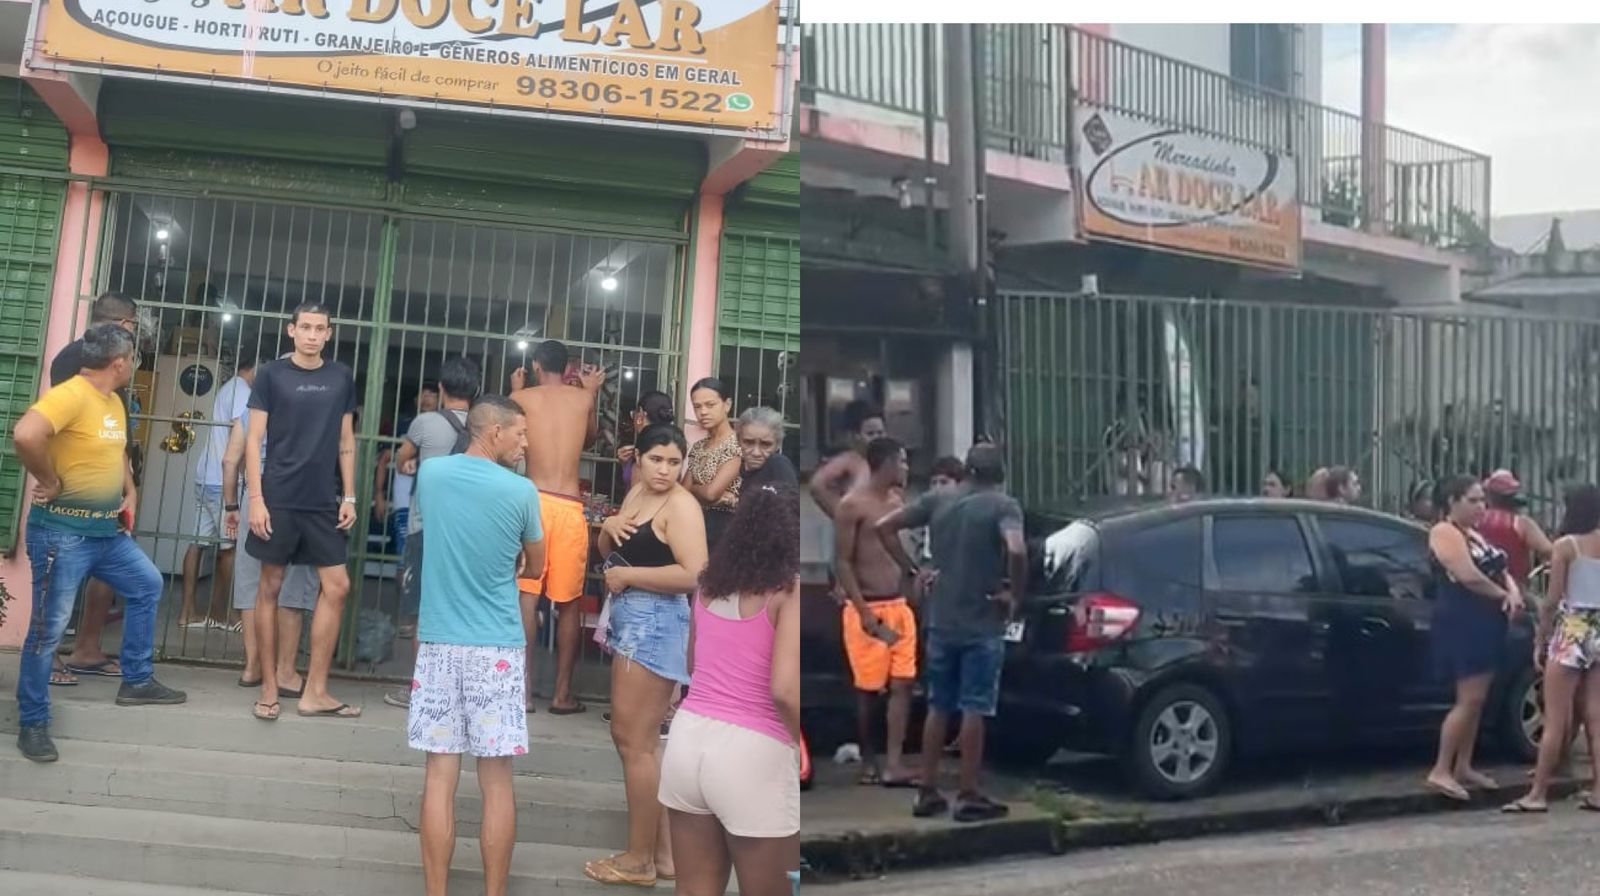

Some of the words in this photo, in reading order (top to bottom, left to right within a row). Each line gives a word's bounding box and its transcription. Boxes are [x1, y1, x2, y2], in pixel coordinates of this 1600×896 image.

[560, 0, 706, 54] LAR
[93, 9, 179, 31] AÇOUGUE
[194, 20, 299, 43] HORTIRUTI
[315, 32, 413, 55] GRANJEIRO
[440, 41, 520, 65] GÊNEROS
[526, 53, 649, 77] ALIMENTÍCIOS
[655, 65, 679, 80] EM
[685, 67, 740, 85] GERAL
[317, 60, 333, 73] O
[333, 61, 369, 79] jeito
[374, 67, 406, 81] fácil
[410, 70, 430, 83] de
[435, 74, 499, 91] comprar
[516, 75, 722, 113] 98306-1522
[49, 504, 91, 518] LACOSTE
